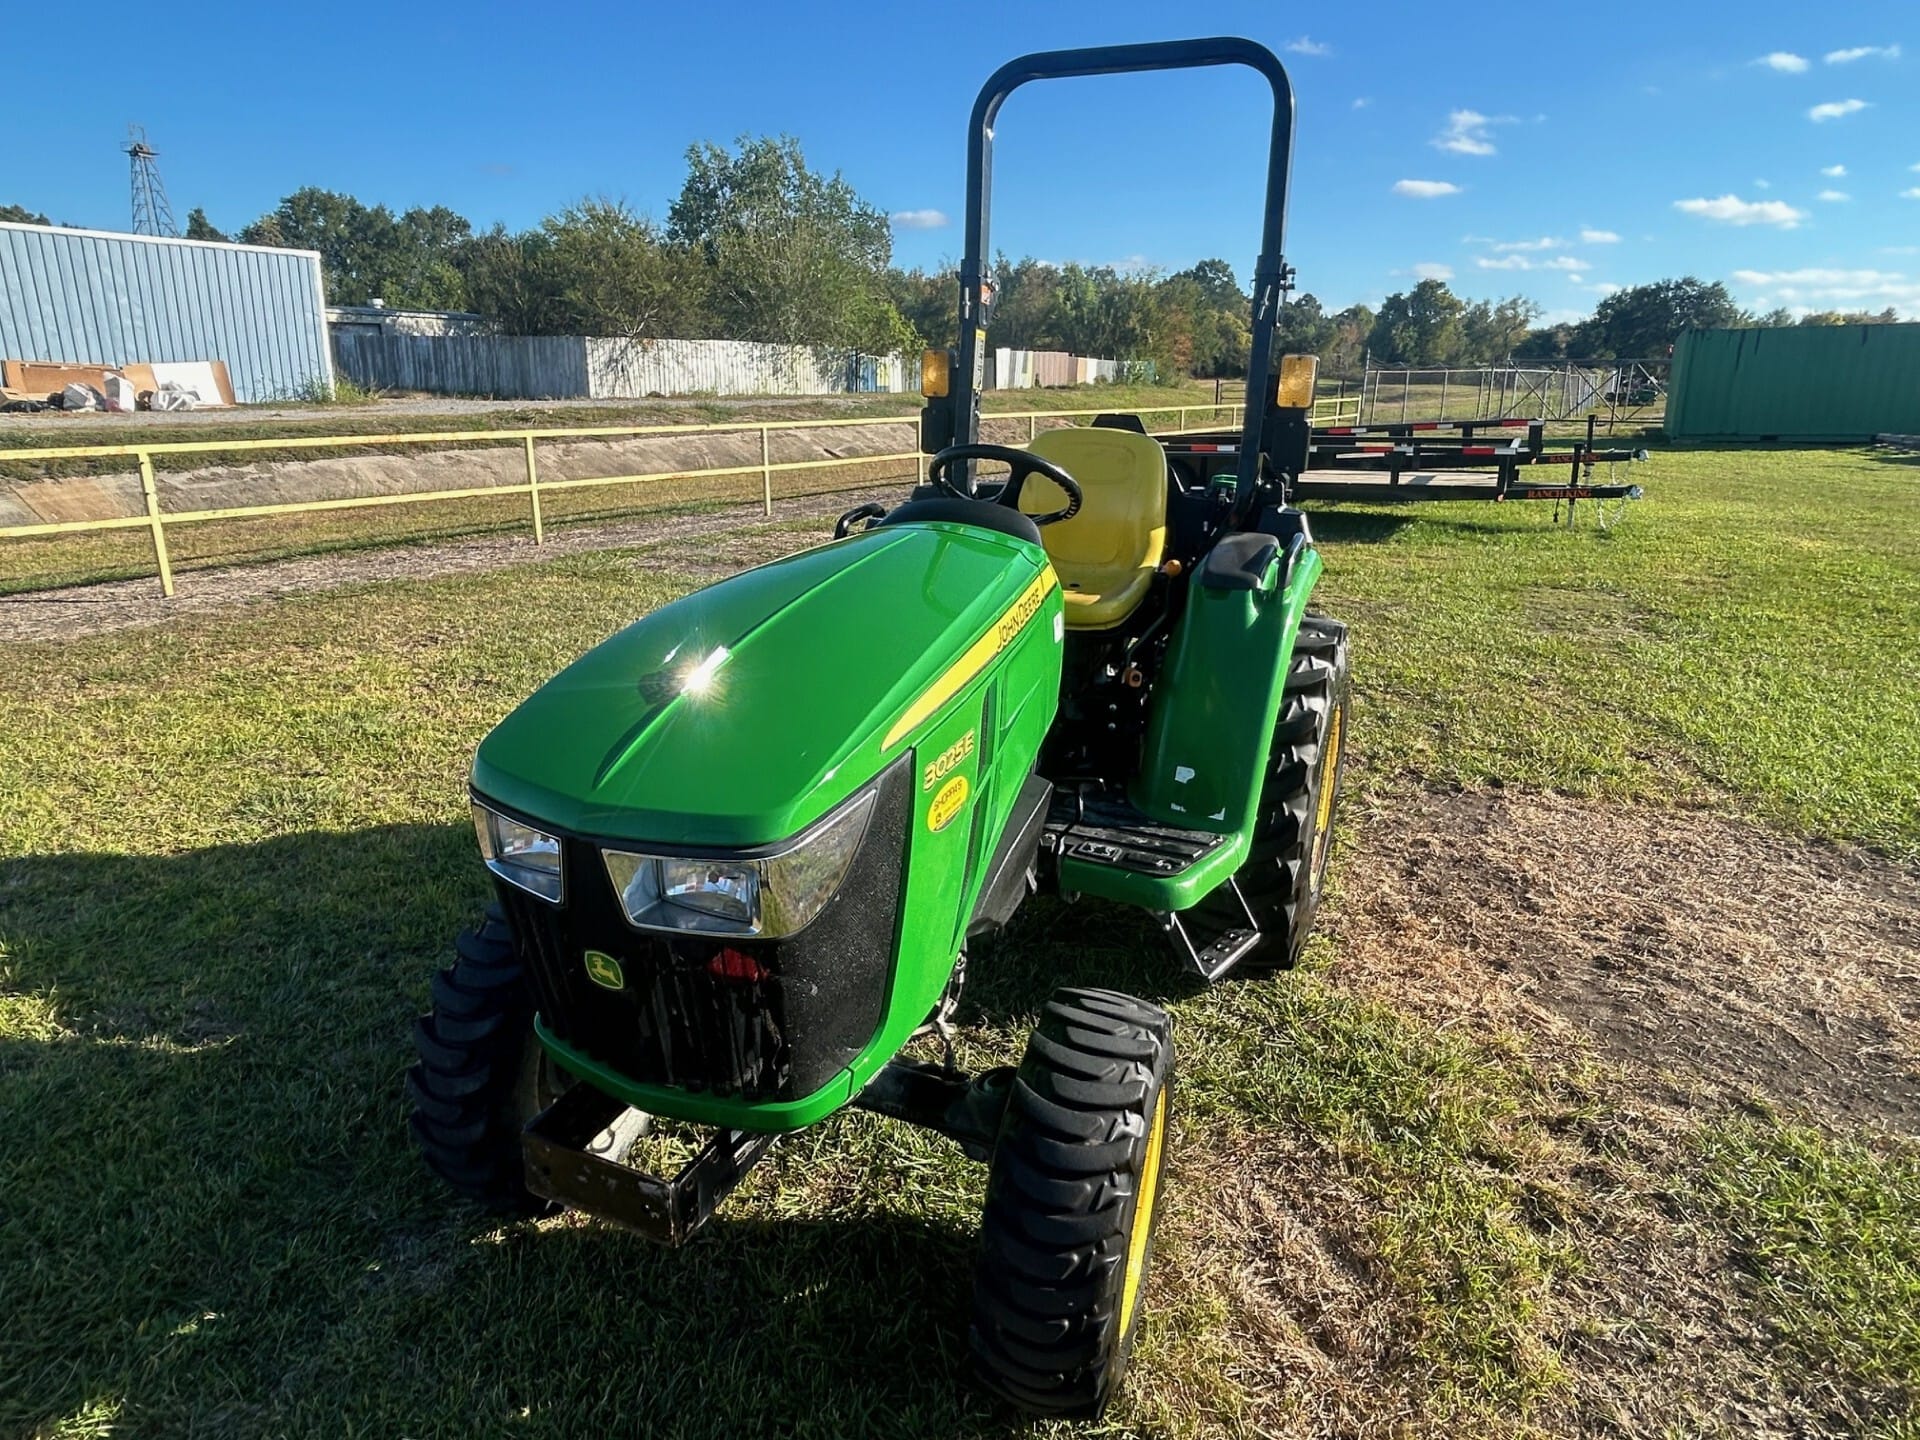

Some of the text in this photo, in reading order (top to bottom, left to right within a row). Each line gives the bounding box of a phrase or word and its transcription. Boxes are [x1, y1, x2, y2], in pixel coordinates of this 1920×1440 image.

[1528, 488, 1592, 498] RANCH KING
[997, 588, 1040, 649] JOHN DEERE
[924, 729, 975, 792] 3025E
